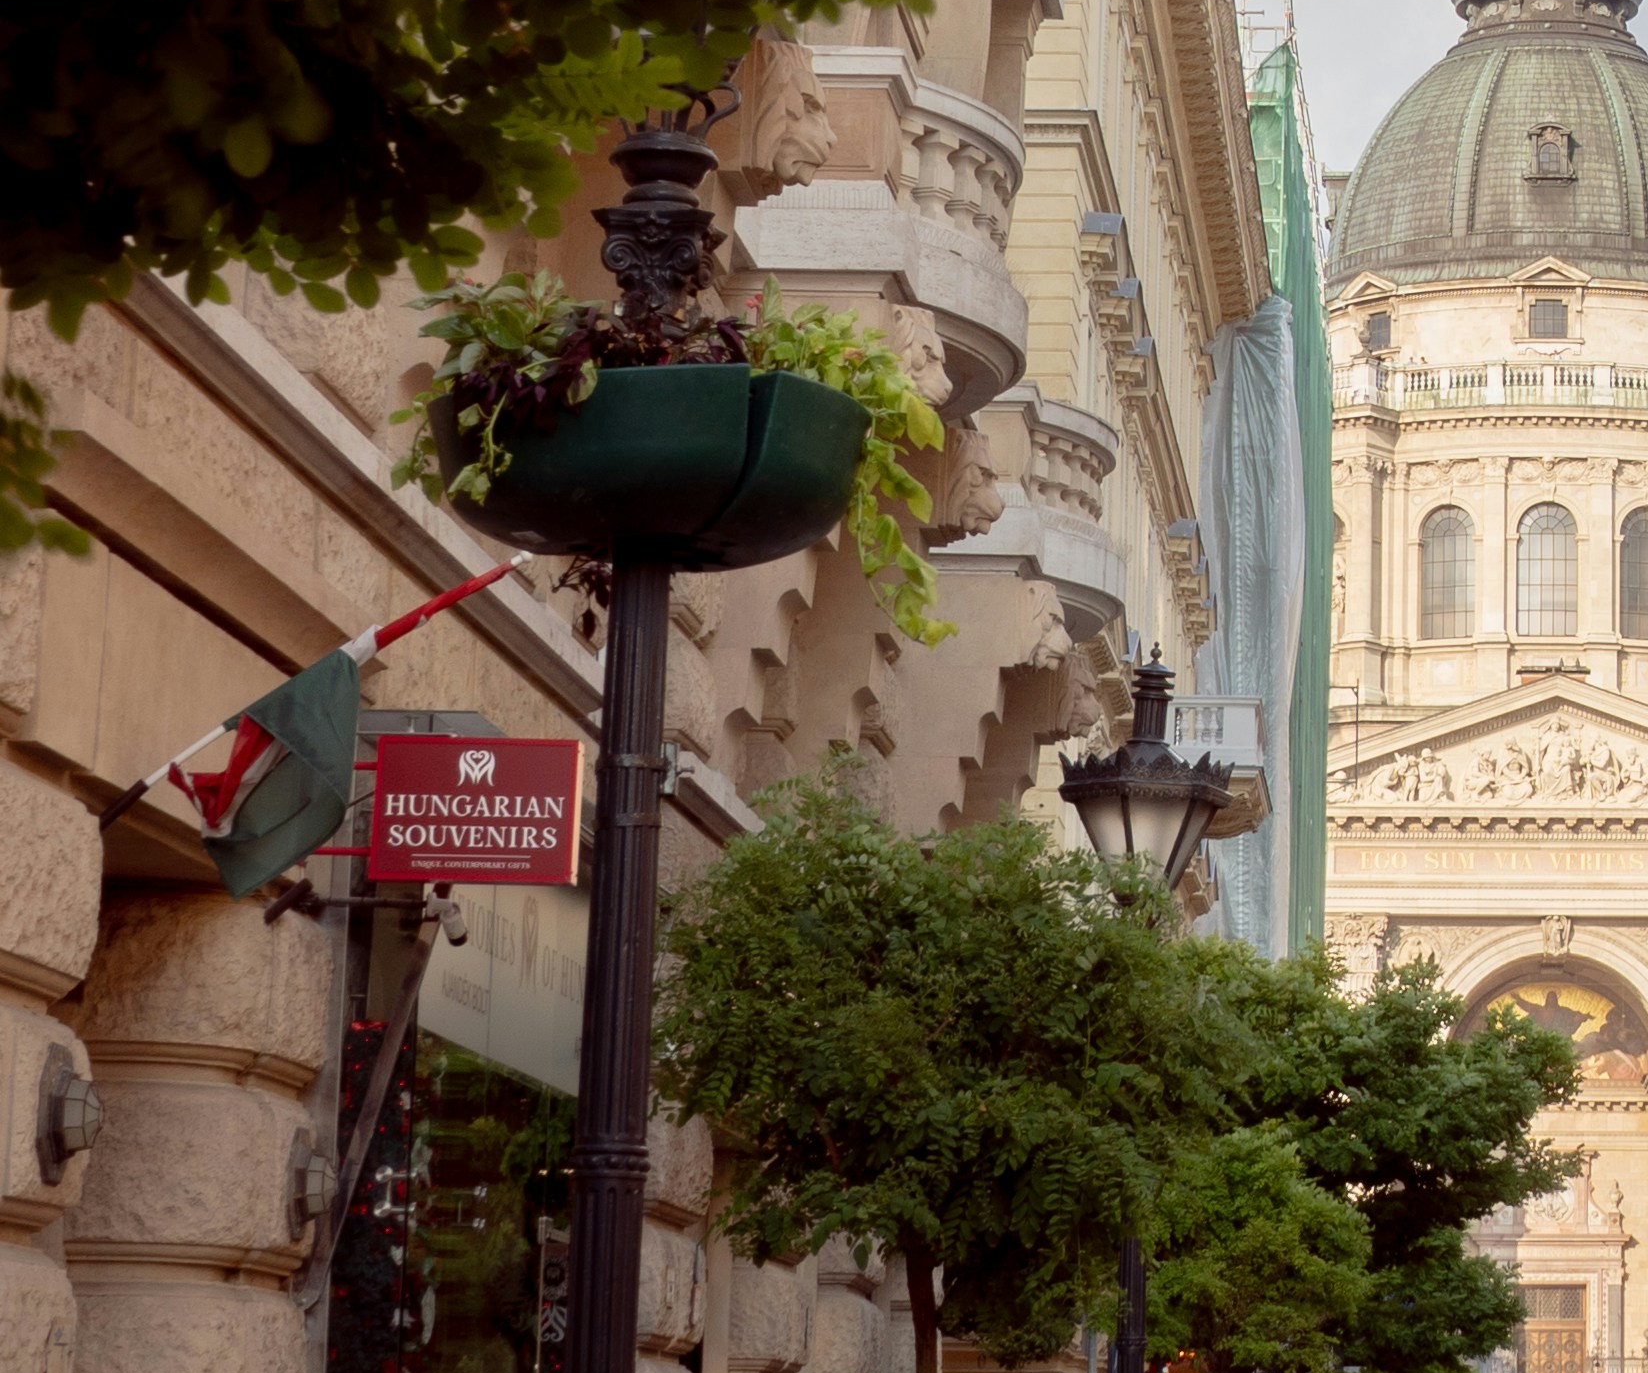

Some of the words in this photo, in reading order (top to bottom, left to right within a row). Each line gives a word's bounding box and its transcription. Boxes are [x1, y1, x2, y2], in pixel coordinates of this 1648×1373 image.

[384, 794, 566, 819] HUNGARIAN
[387, 824, 558, 849] SOUVENIRS
[1360, 850, 1408, 870] EGO
[1424, 851, 1475, 870] SUM
[1495, 852, 1534, 870] VIA
[1550, 852, 1645, 871] VERITAS
